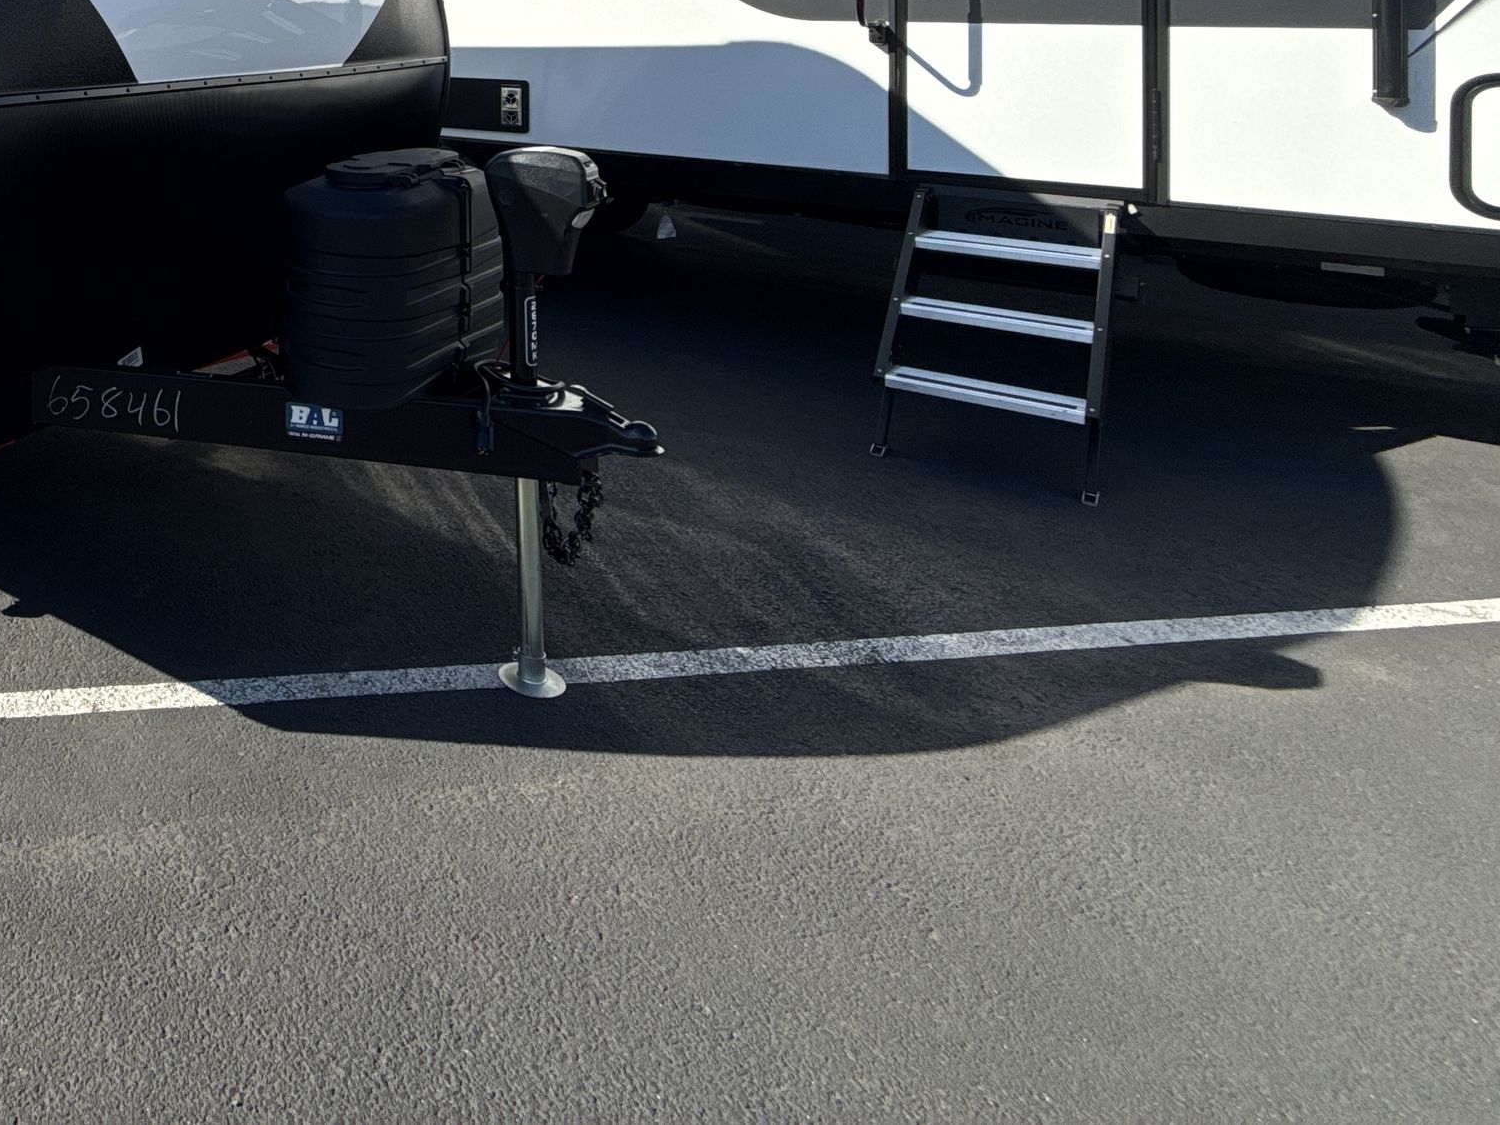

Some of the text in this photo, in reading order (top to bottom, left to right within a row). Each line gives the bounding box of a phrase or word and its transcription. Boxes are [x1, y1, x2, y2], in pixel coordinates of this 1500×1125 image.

[971, 213, 1068, 231] IMAGINE
[46, 375, 182, 433] 658461
[291, 405, 339, 427] BAL
